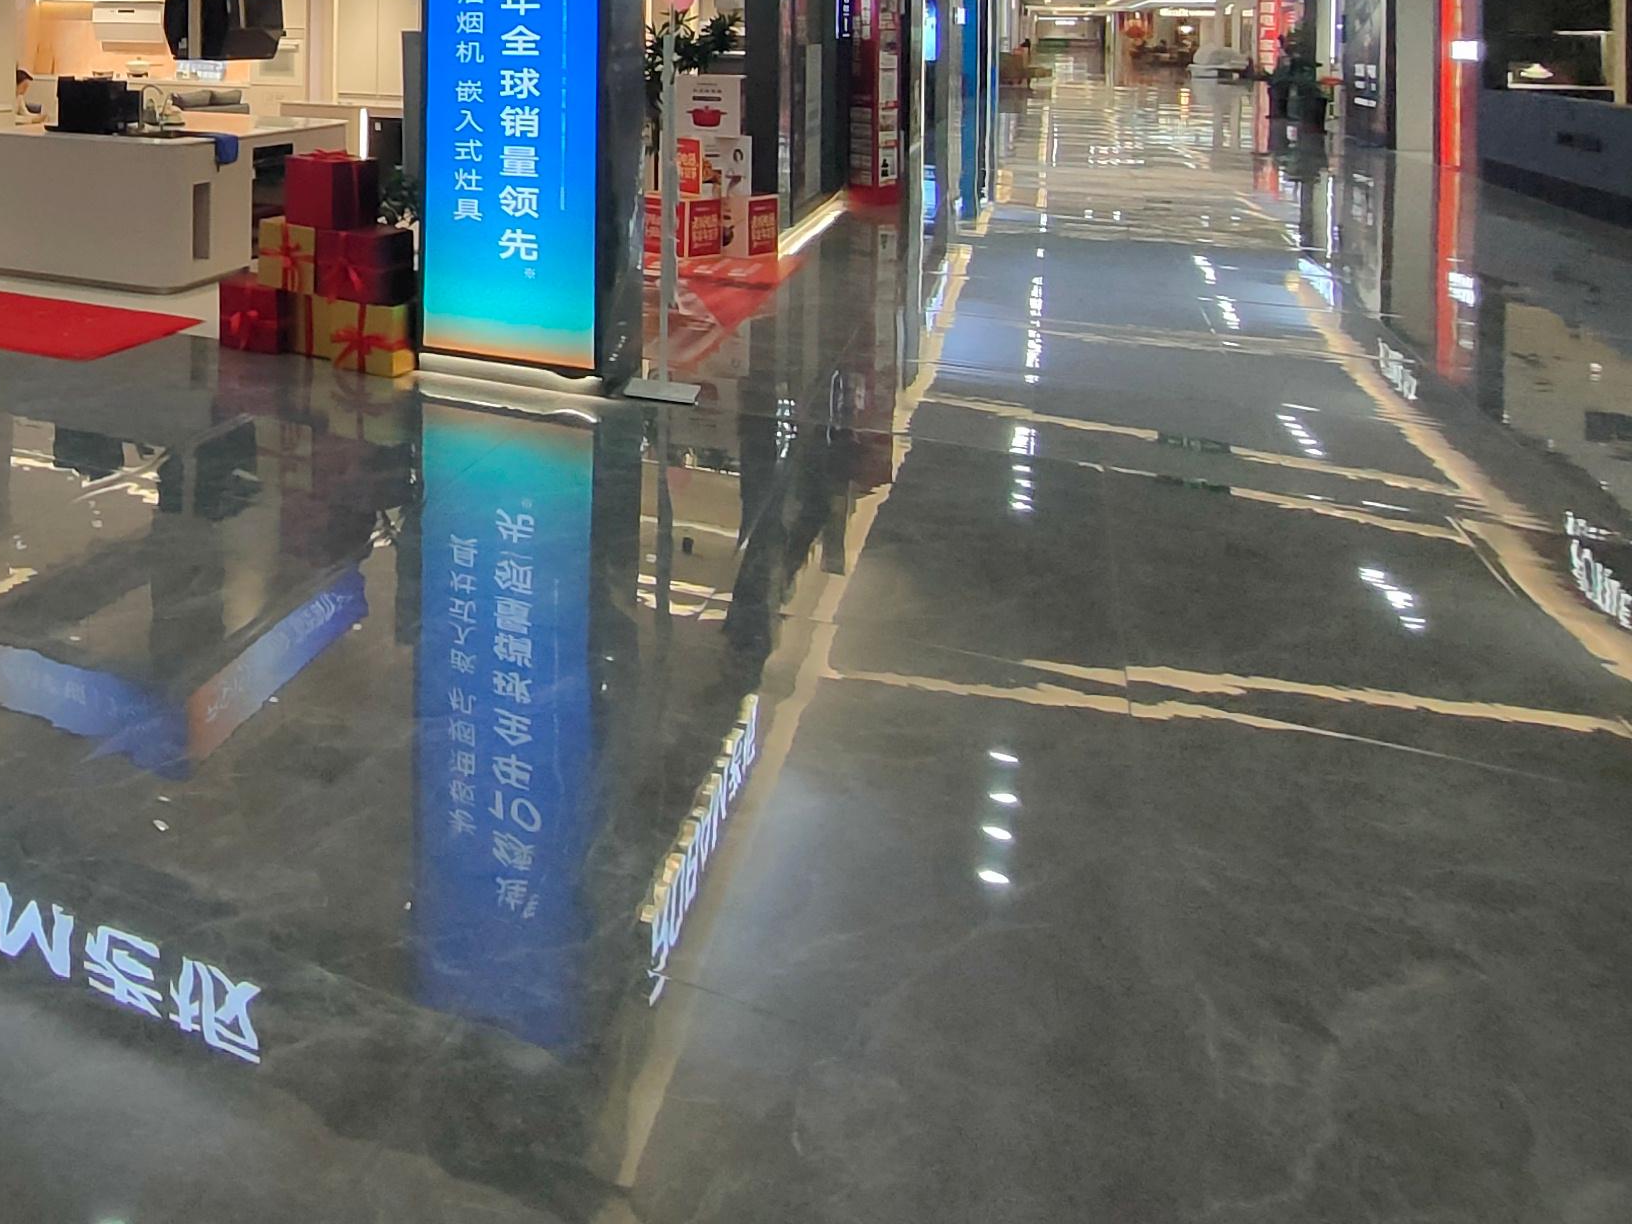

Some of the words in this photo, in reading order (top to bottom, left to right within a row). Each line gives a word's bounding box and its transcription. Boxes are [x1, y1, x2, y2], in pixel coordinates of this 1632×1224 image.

[453, 79, 485, 222] 嵌入式灶具
